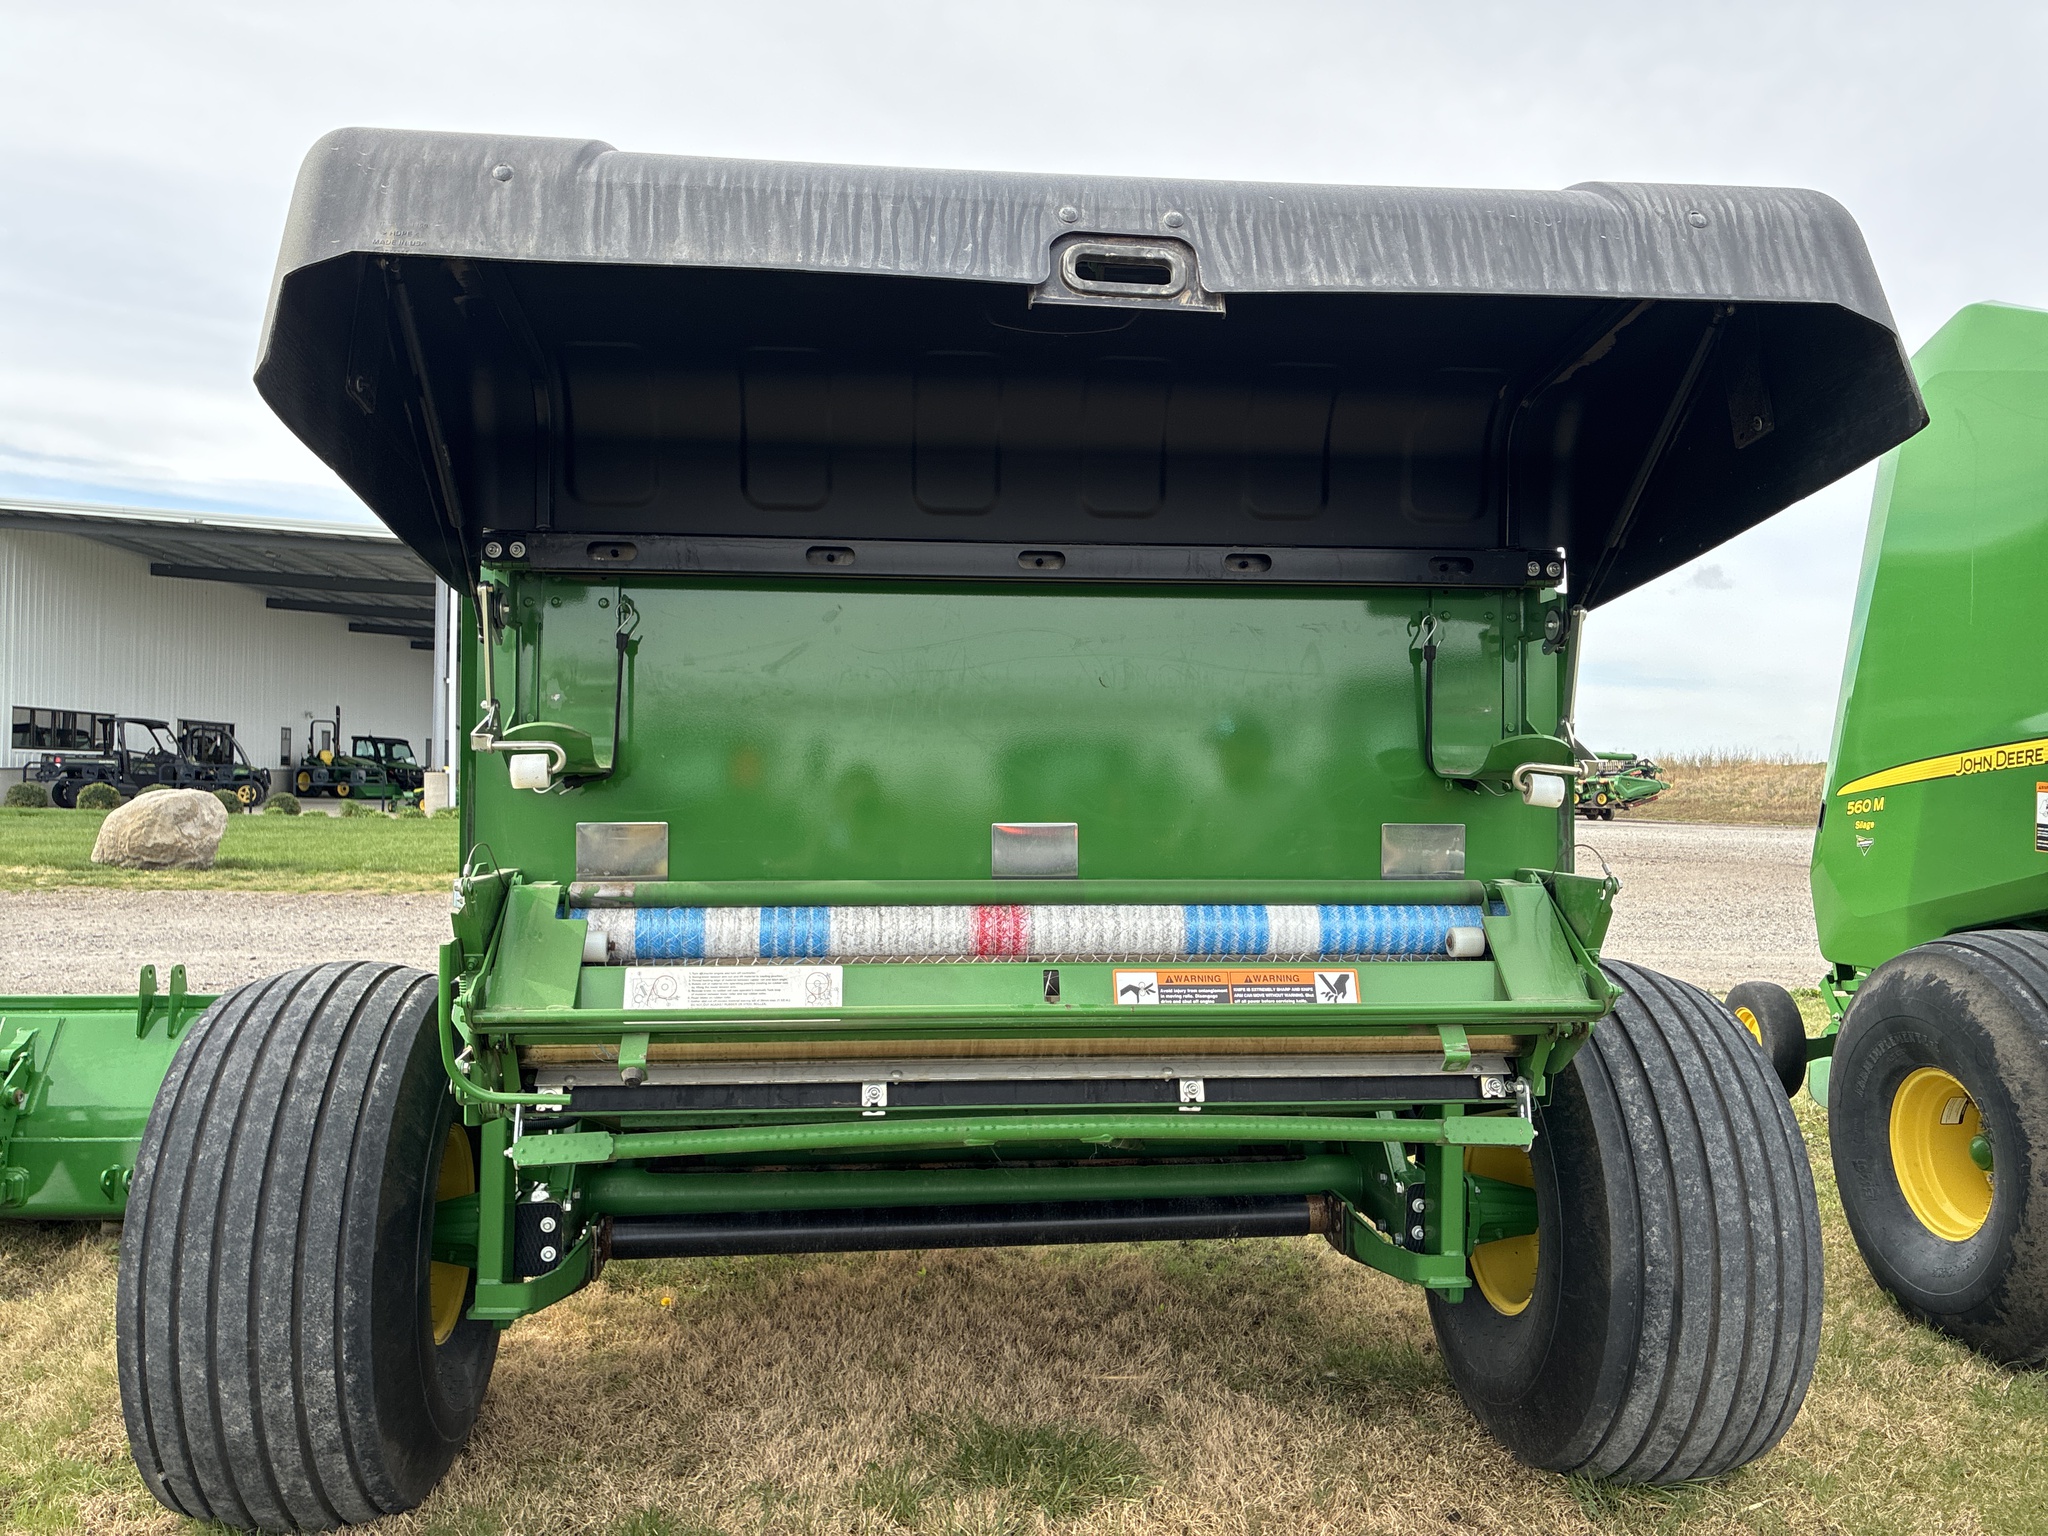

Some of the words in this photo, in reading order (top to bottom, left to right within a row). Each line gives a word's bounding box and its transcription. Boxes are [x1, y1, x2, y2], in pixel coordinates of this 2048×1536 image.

[1955, 754, 1993, 775] JOHN
[1995, 747, 2044, 768] DEERE
[1846, 799, 1872, 816] 560
[1873, 796, 1885, 812] M
[1174, 974, 1221, 983] WARNING
[1253, 974, 1300, 983] WARNING
